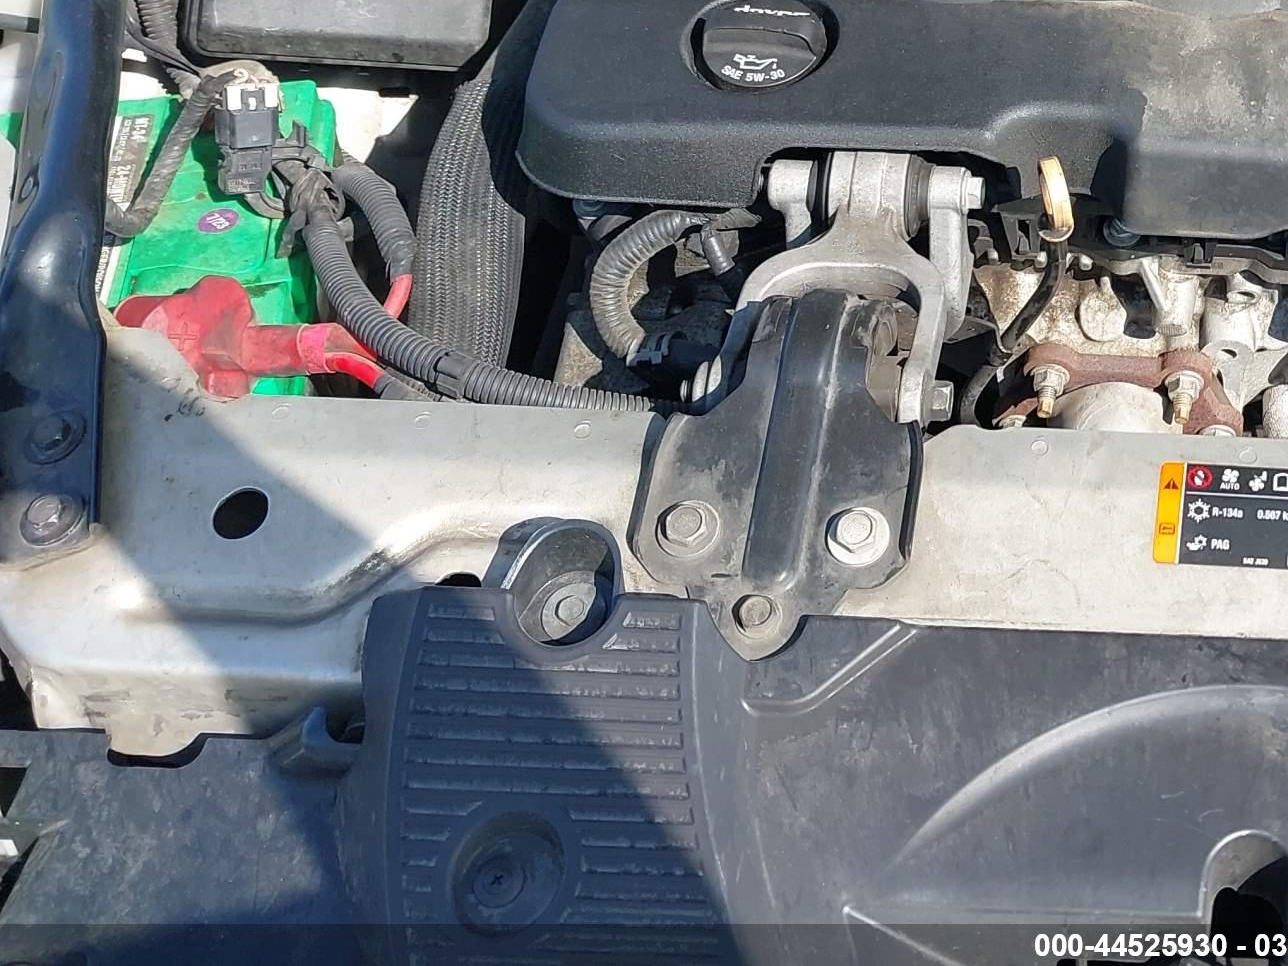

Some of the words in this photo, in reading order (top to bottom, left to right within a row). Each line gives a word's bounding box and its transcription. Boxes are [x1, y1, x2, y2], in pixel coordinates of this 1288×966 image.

[721, 65, 744, 80] SAE
[745, 69, 786, 82] 5W-30
[1220, 481, 1240, 490] AUTO
[1210, 538, 1230, 551] PAG
